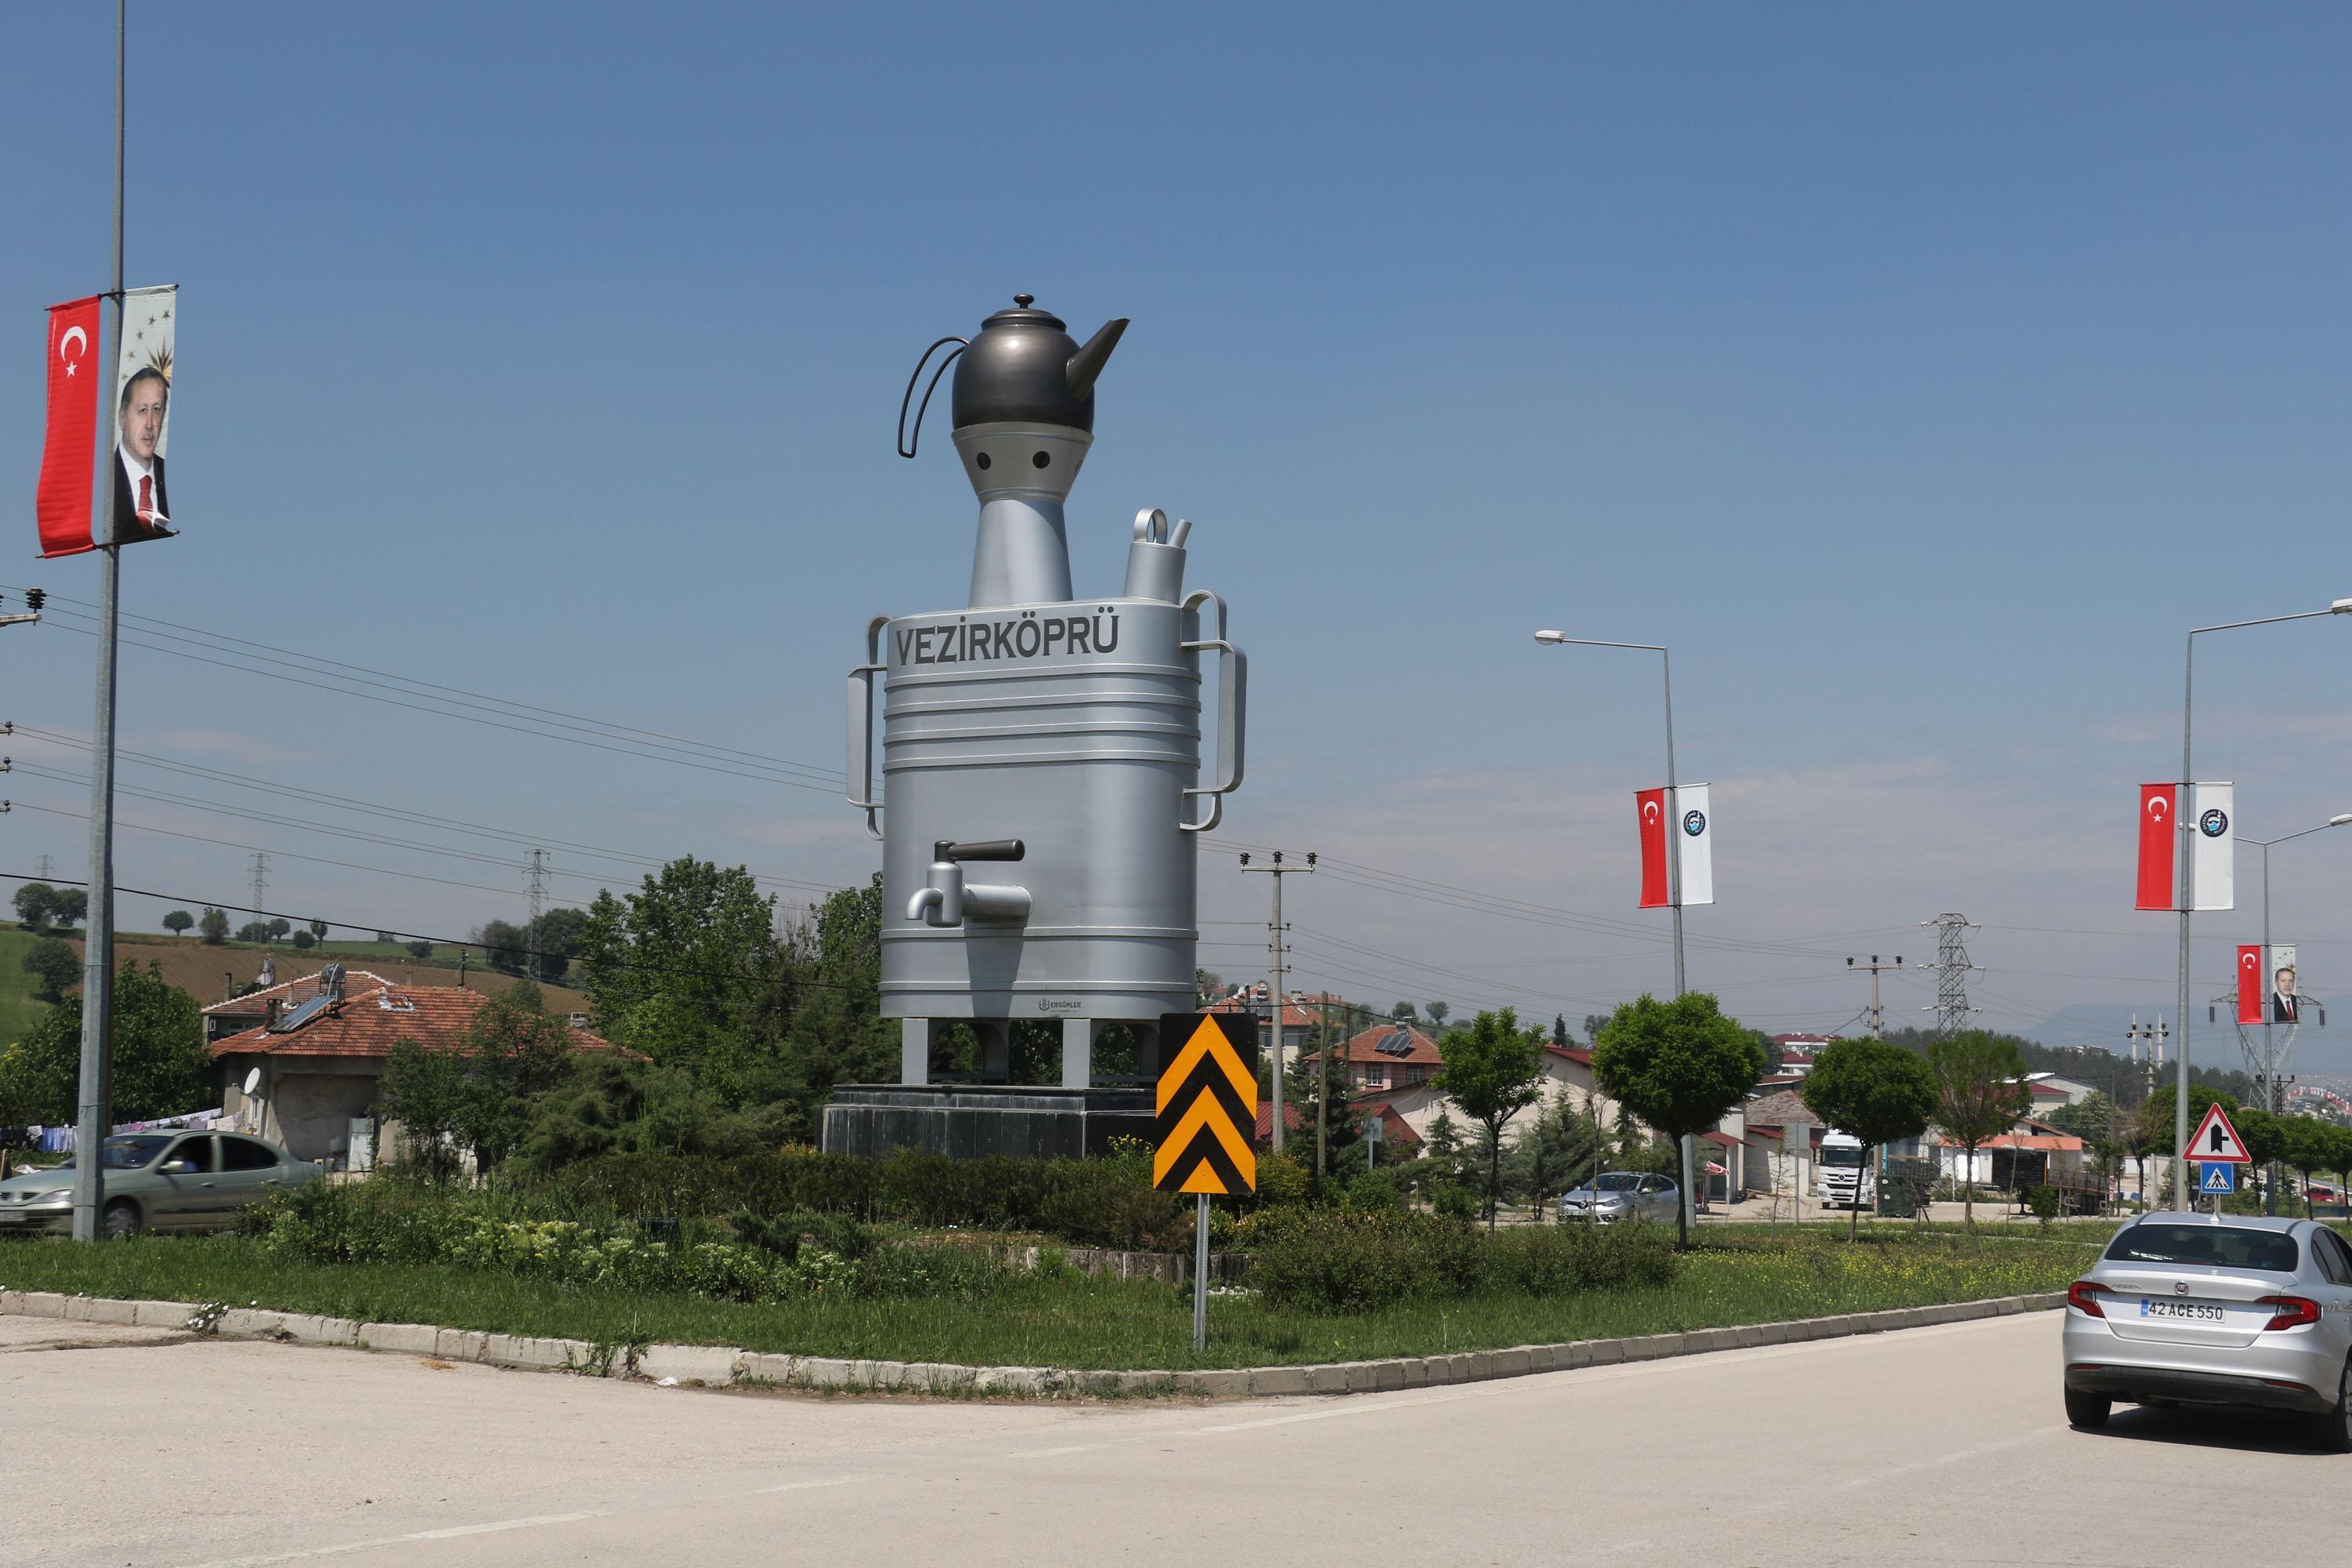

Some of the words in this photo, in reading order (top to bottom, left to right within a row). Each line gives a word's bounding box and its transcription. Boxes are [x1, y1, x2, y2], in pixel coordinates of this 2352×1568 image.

[895, 606, 1119, 666] VEZİRKÖPRÜ
[2148, 1301, 2165, 1316] 42
[2169, 1303, 2194, 1318] ACE
[2197, 1305, 2223, 1320] 550
